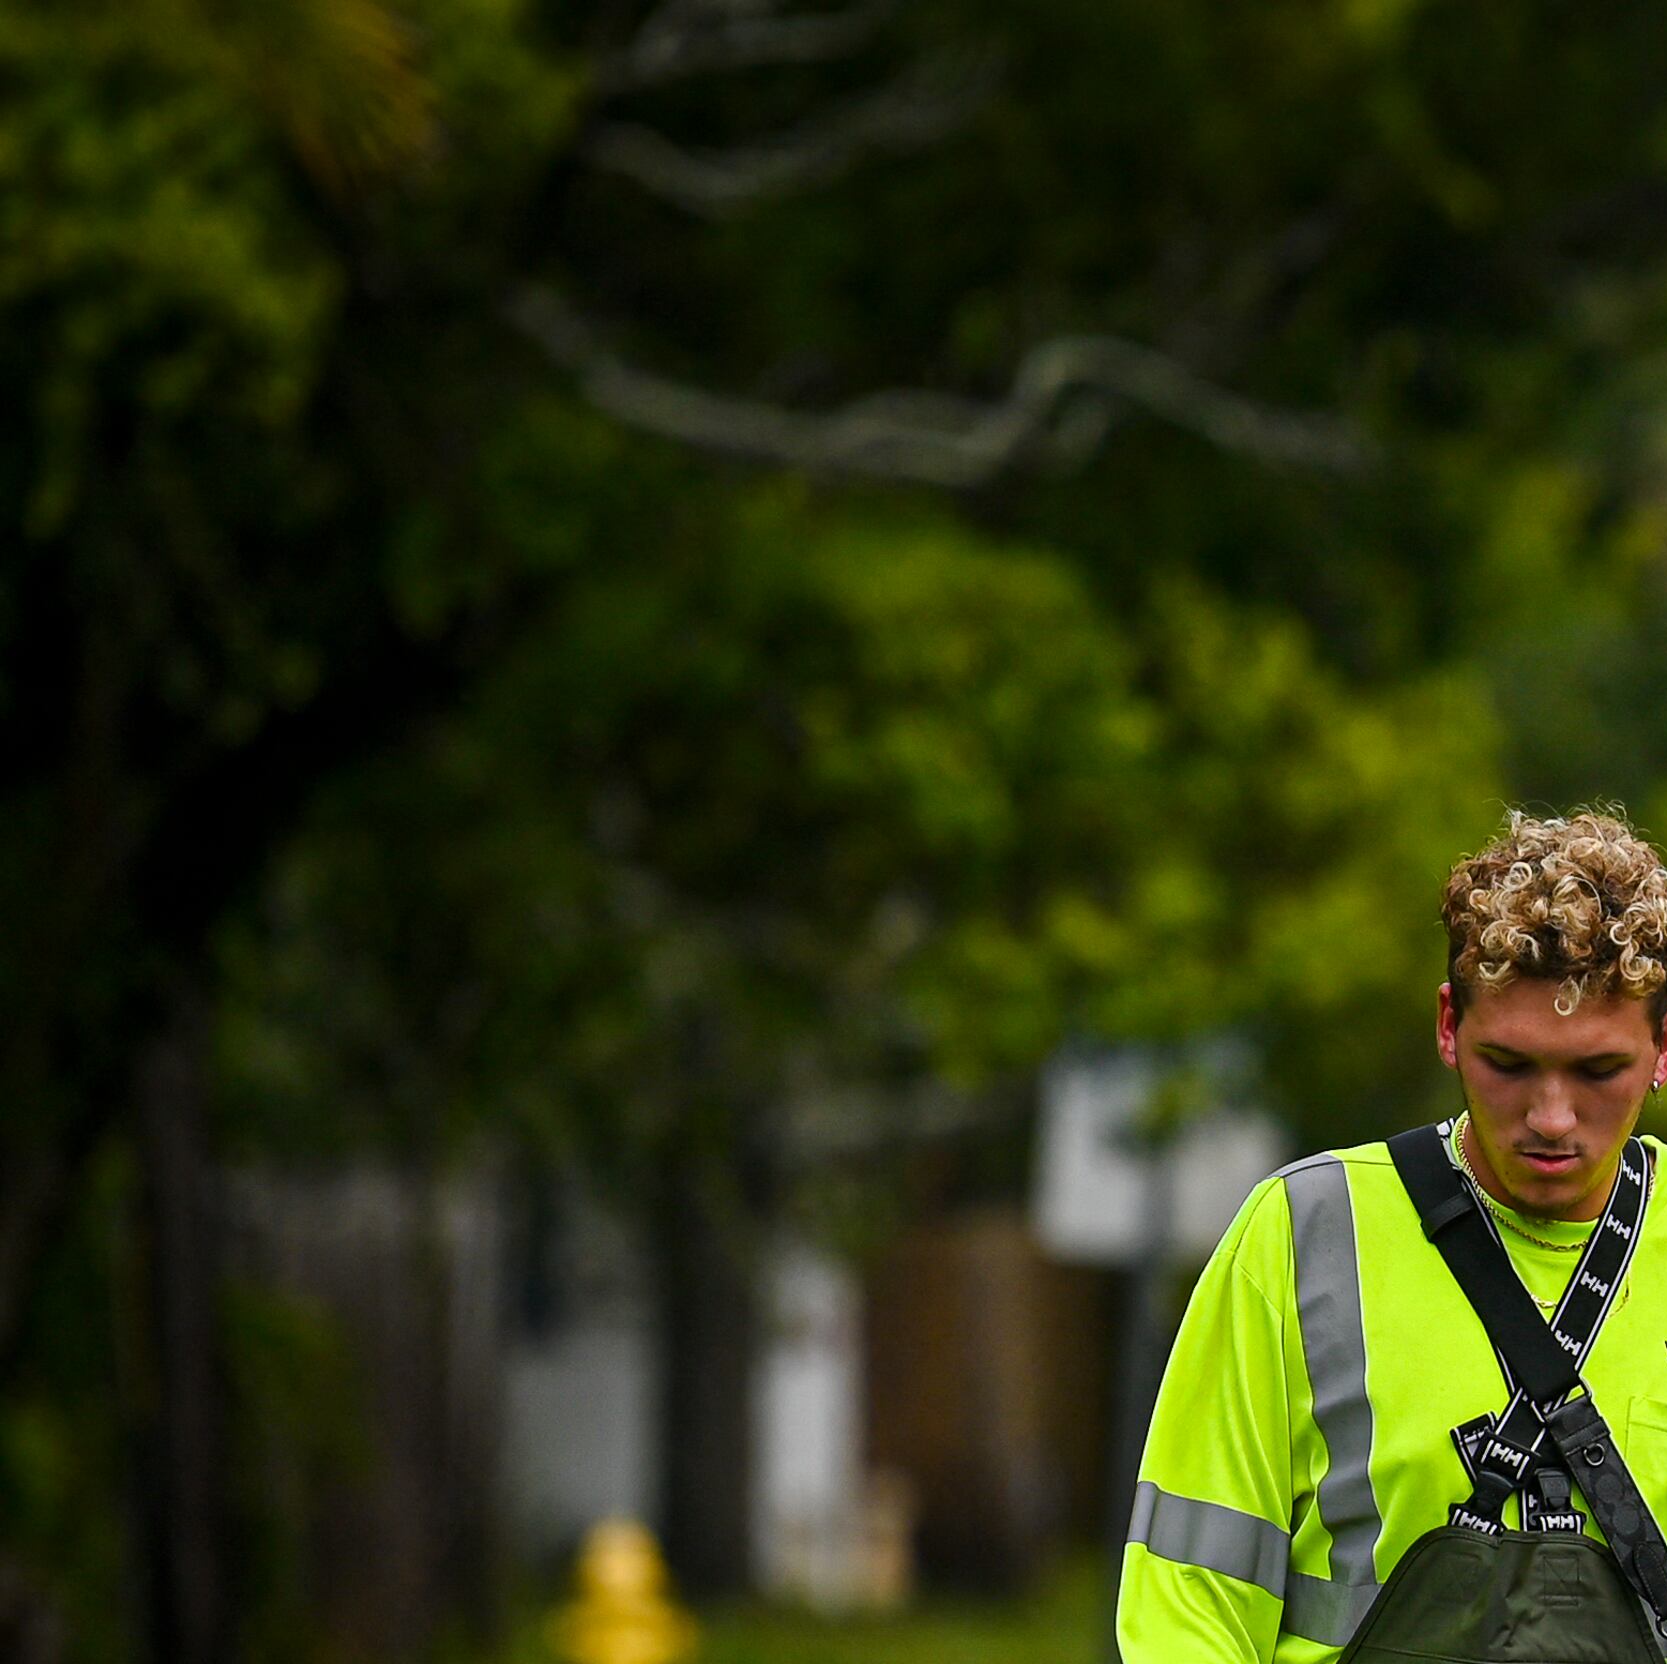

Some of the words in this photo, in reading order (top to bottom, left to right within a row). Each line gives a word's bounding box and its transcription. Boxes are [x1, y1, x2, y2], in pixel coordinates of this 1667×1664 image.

[1606, 1213, 1632, 1240] HH
[1580, 1271, 1609, 1298] HH
[1490, 1442, 1524, 1468] HH
[1458, 1511, 1492, 1532] HH
[1546, 1515, 1575, 1529] HH
